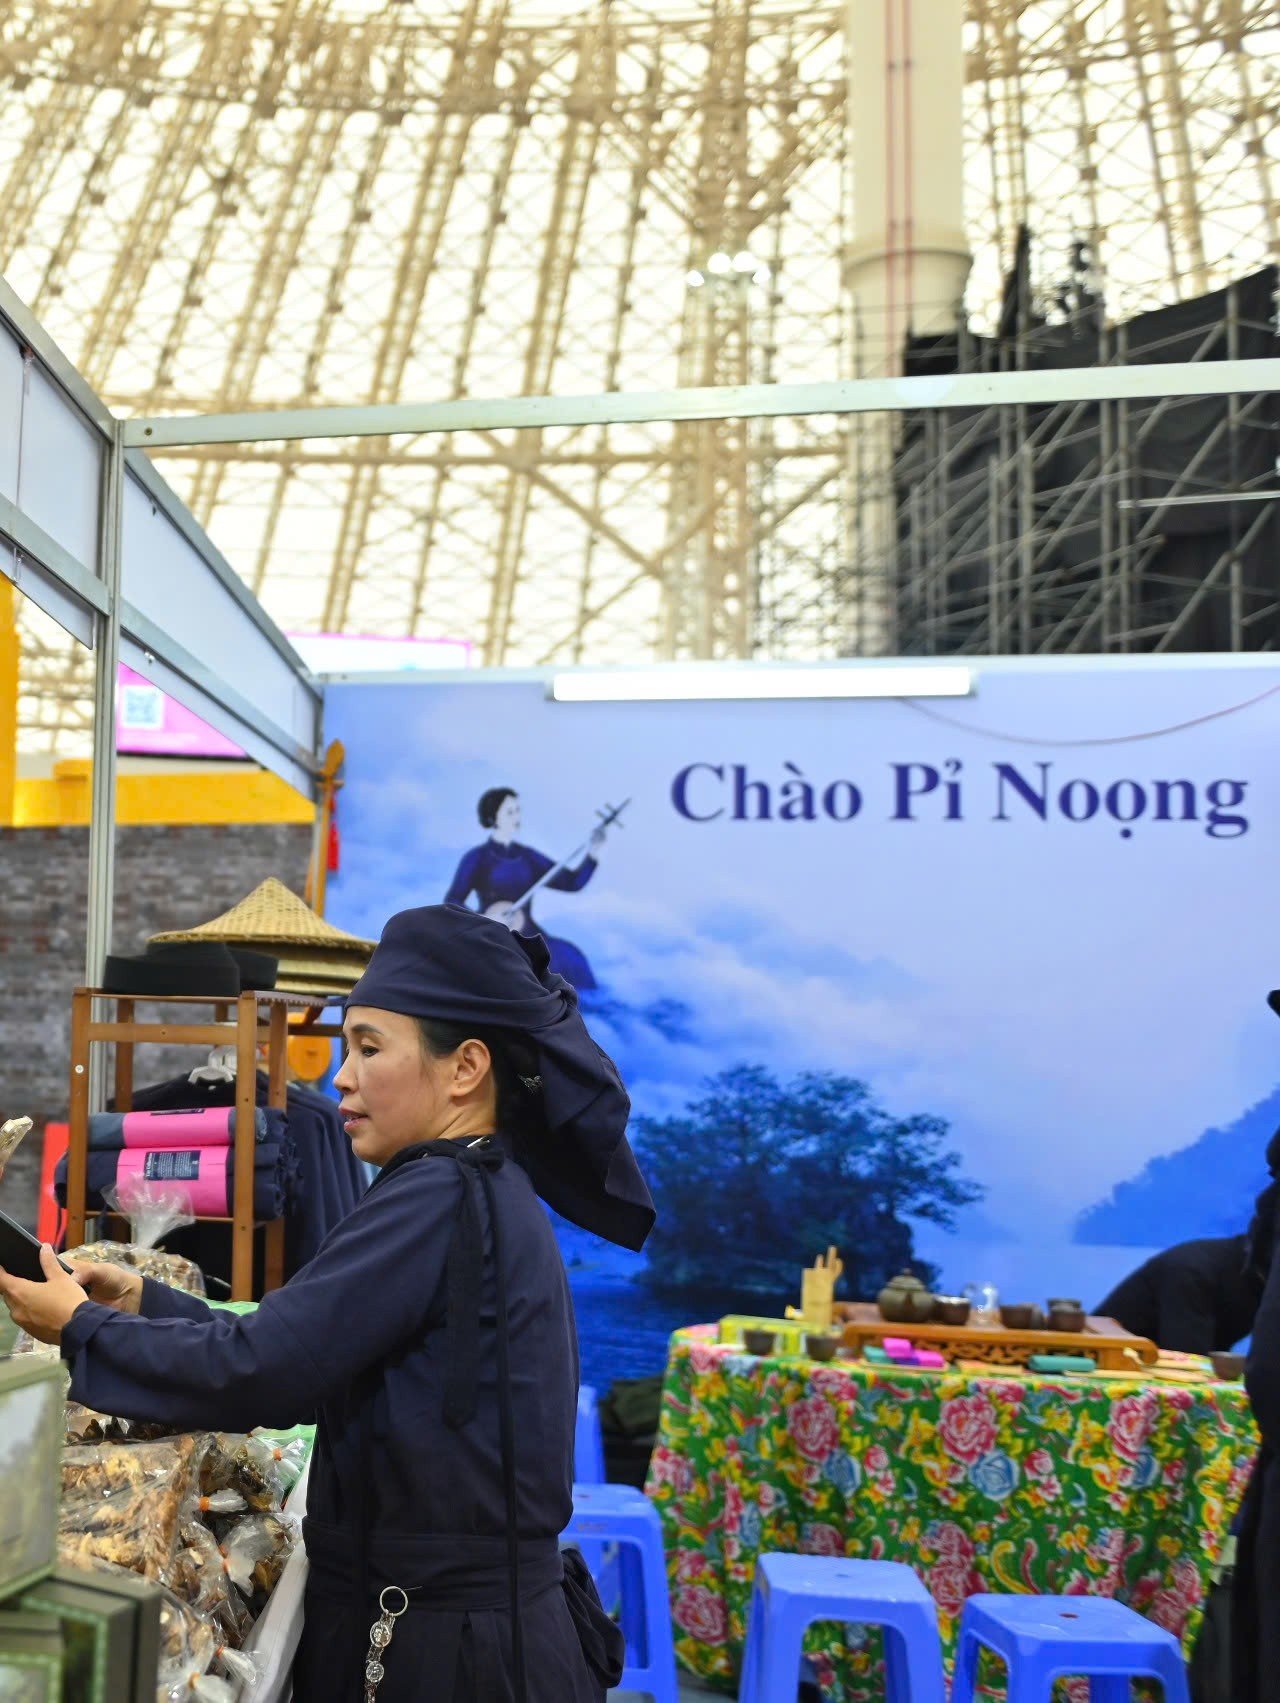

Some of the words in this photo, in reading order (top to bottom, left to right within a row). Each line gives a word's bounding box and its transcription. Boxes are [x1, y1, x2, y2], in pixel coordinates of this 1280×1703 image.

[670, 760, 863, 822] Chào
[889, 758, 964, 821] Pỉ
[992, 760, 1250, 840] Noọng
